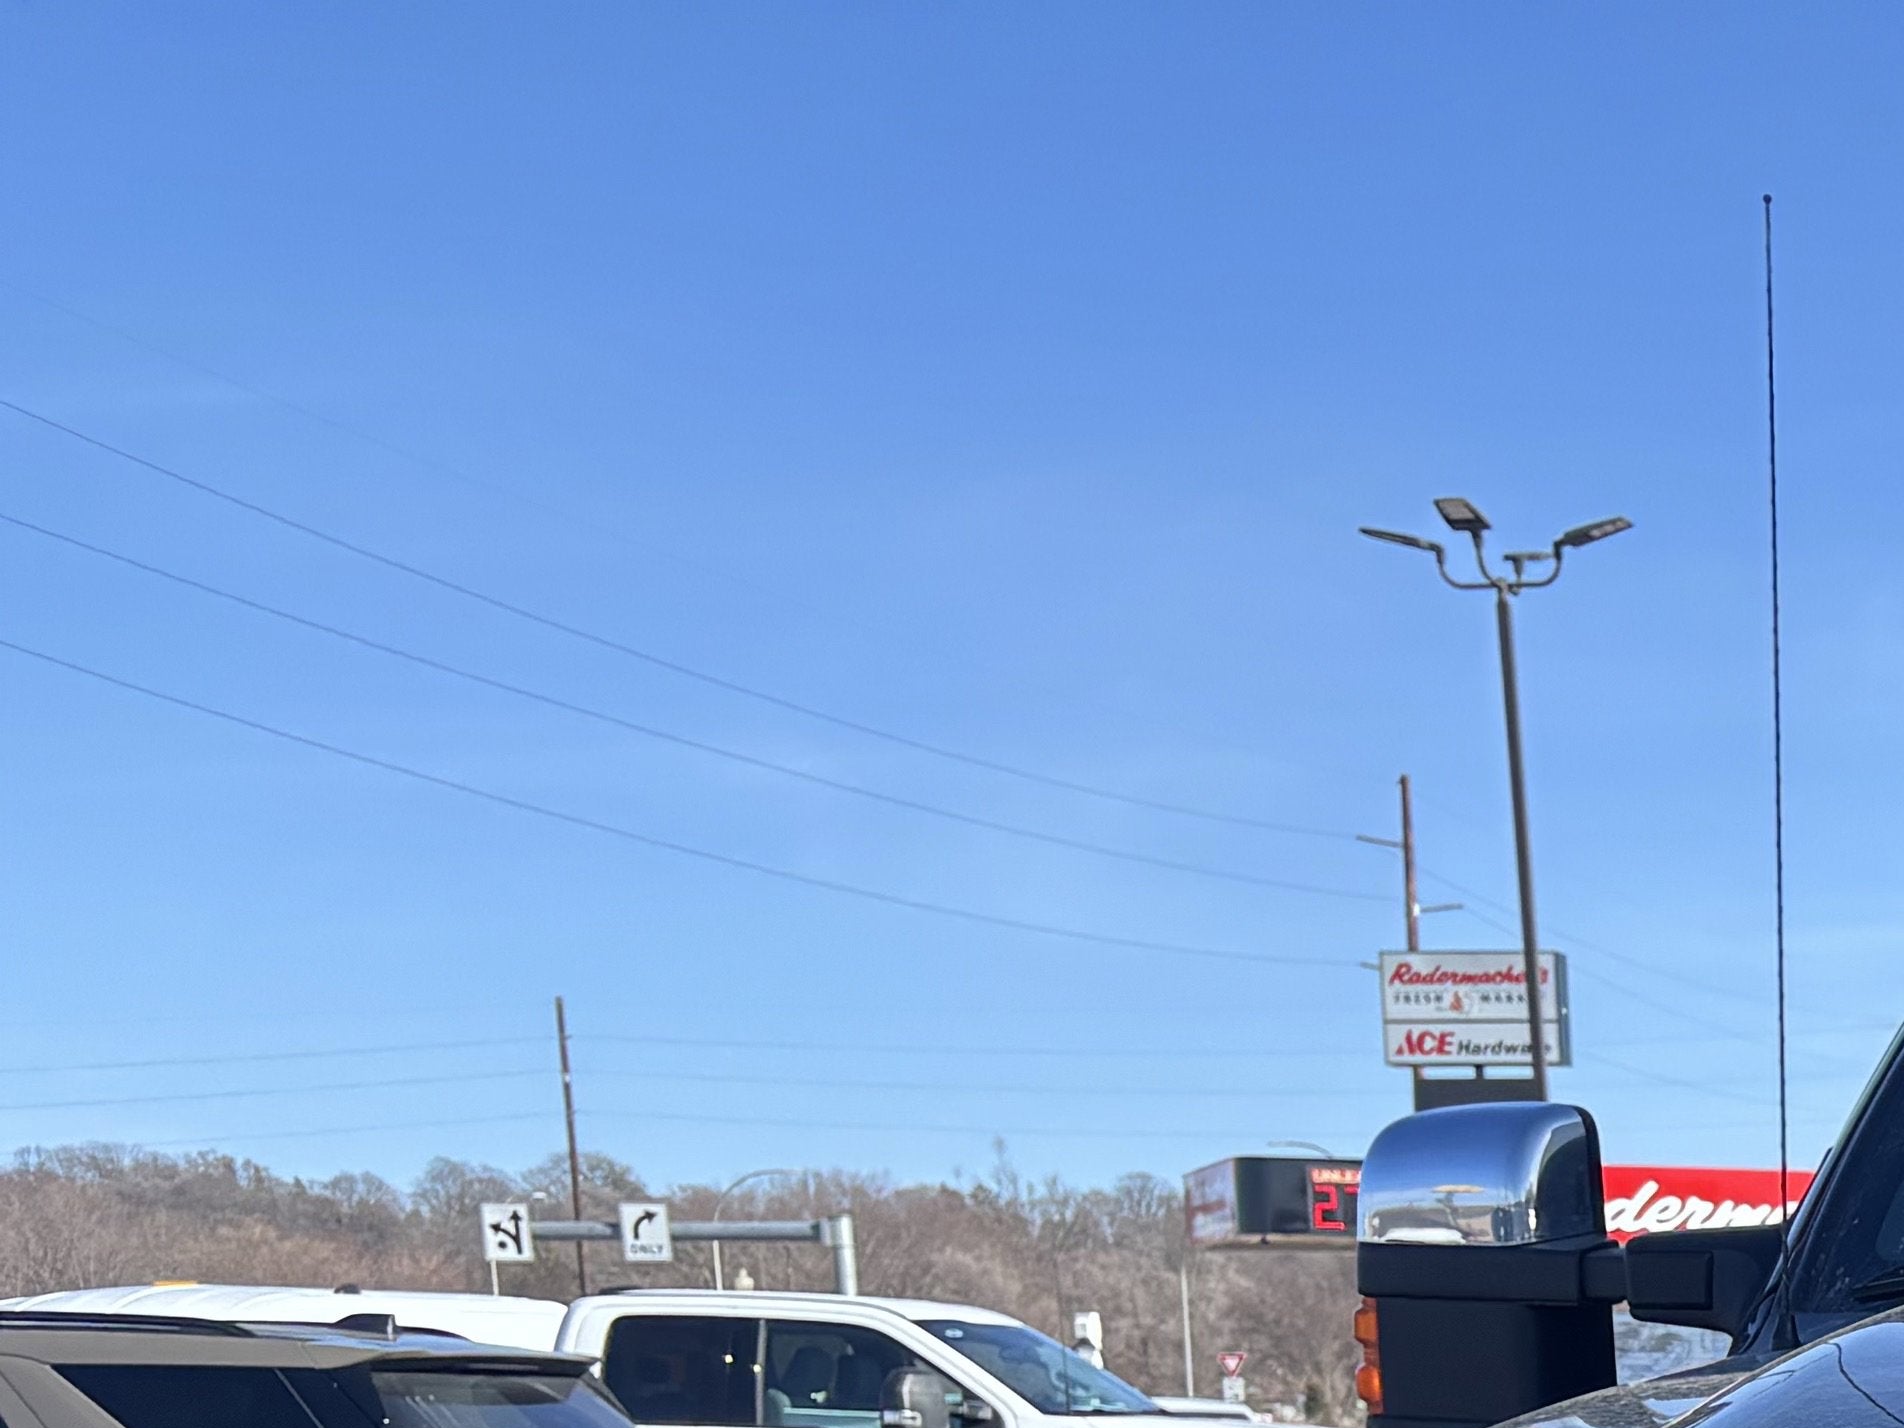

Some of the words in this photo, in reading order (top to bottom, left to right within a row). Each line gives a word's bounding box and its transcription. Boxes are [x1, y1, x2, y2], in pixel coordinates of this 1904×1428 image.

[1389, 962, 1548, 986] Radermaches
[1396, 1028, 1455, 1056] ACE
[1456, 1039, 1552, 1056] Hardwae
[629, 1243, 663, 1255] ONLY
